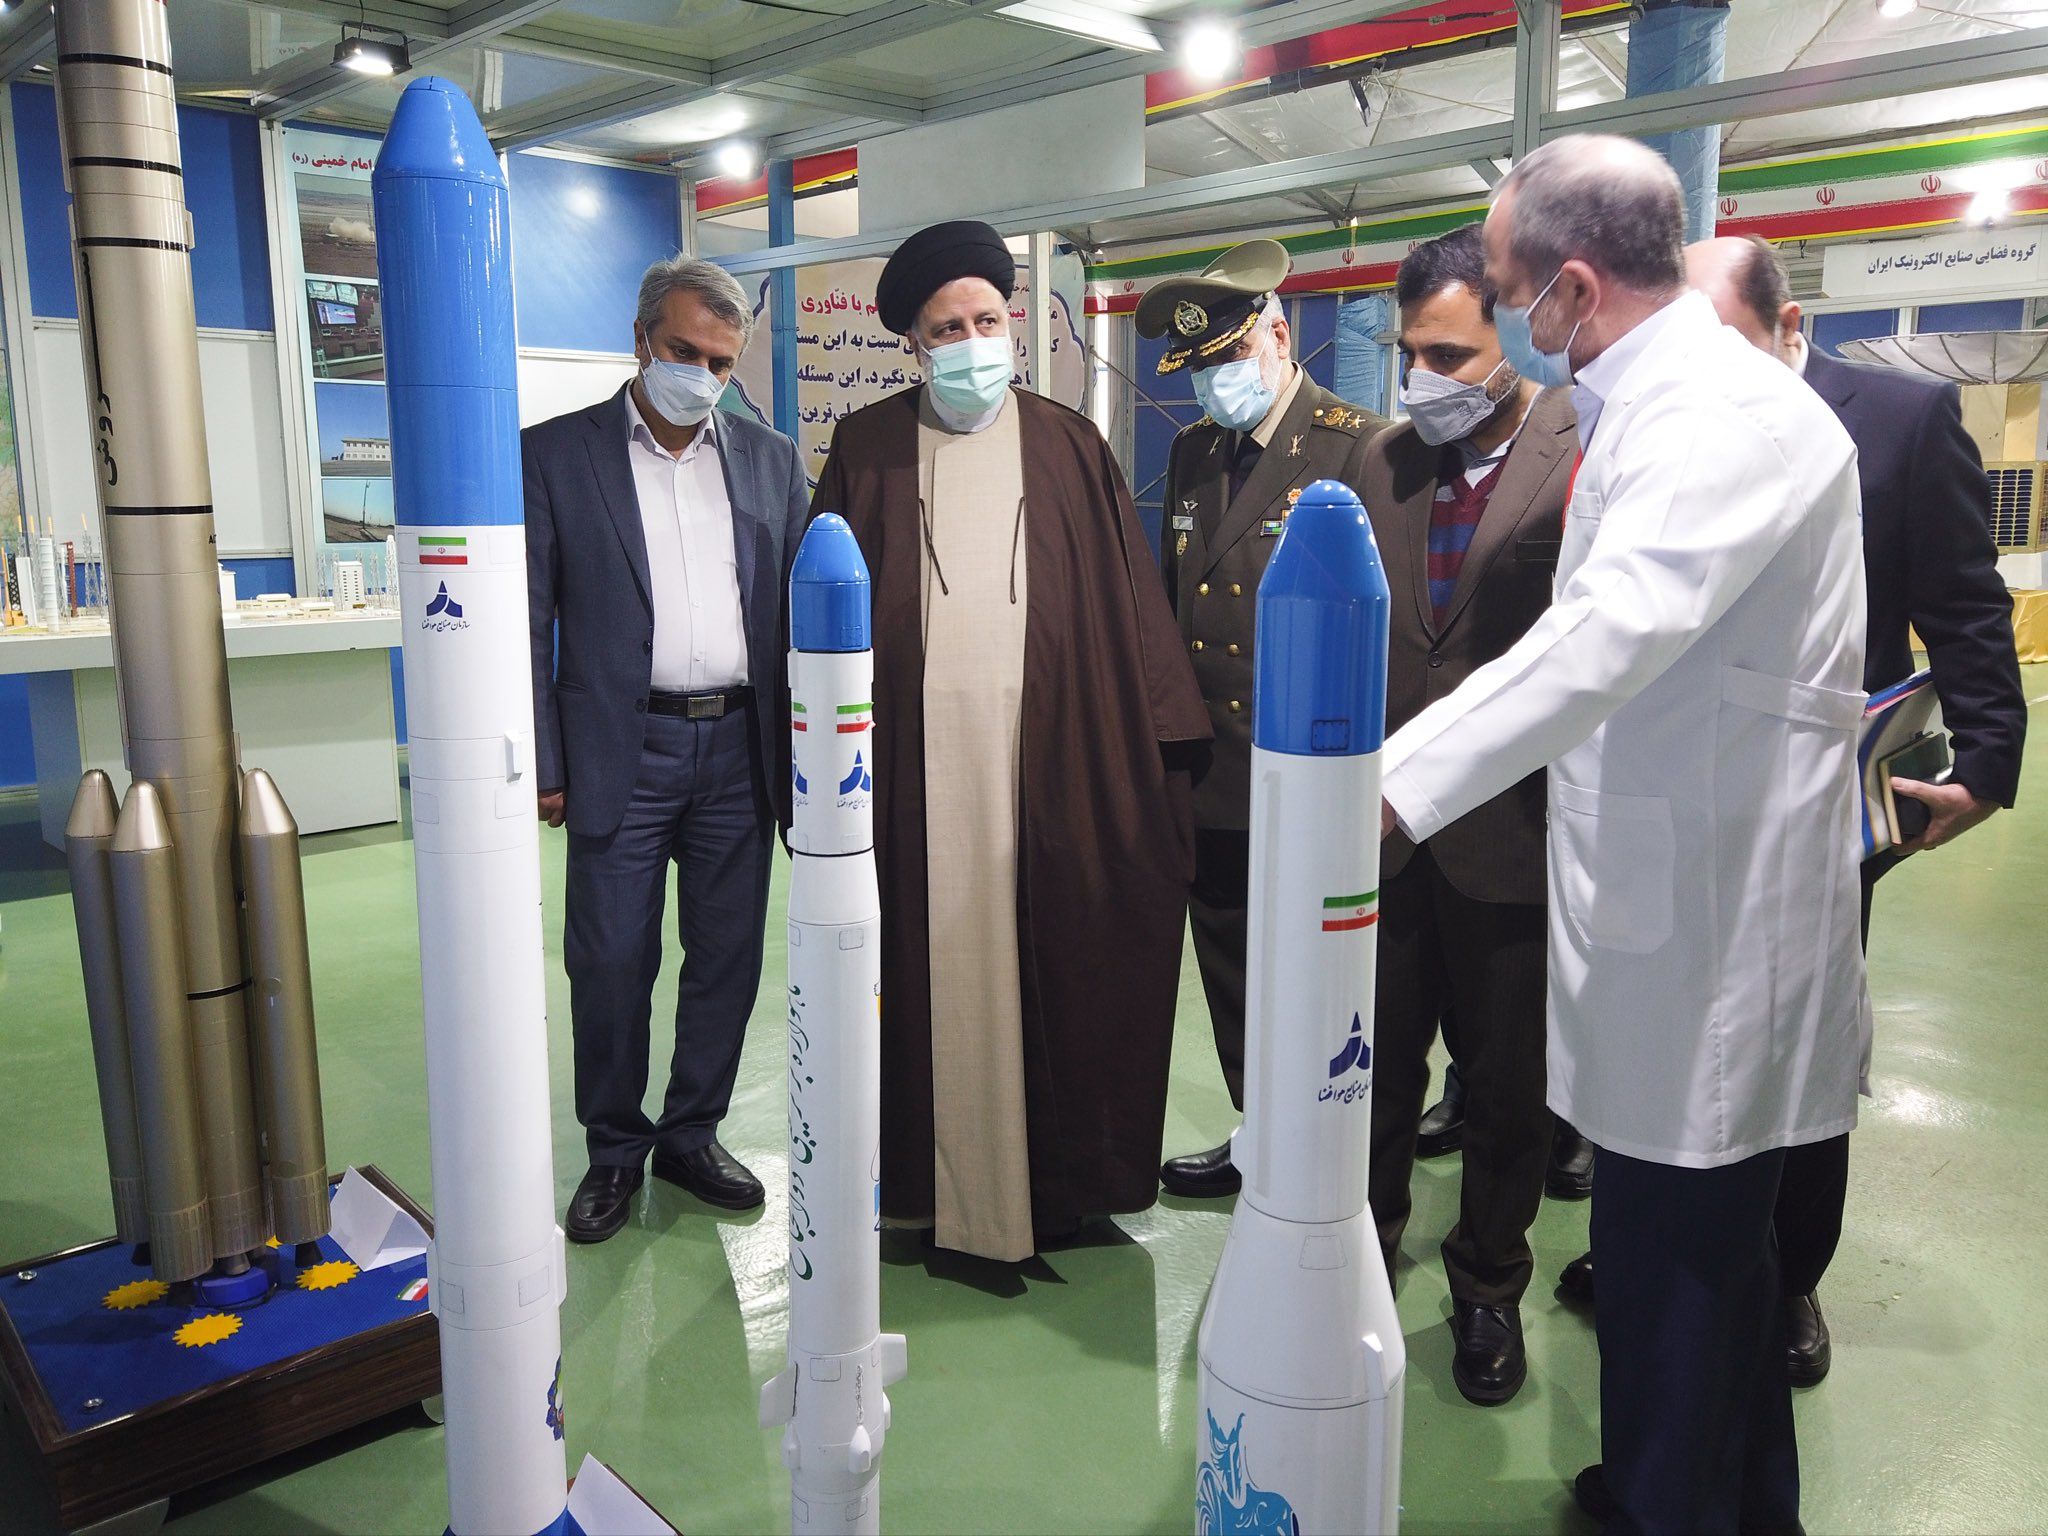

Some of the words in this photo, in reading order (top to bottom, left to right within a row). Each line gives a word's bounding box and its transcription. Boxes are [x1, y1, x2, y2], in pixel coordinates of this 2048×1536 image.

[312, 155, 348, 168] خمینی
[351, 158, 373, 172] امام
[1895, 252, 1943, 270] الکترونیک
[1944, 250, 1973, 268] صنایع
[1975, 245, 2008, 265] فضایی
[2010, 243, 2037, 262] گروه
[1868, 257, 1892, 274] ایران
[851, 294, 862, 315] با
[823, 329, 847, 351] این
[850, 334, 863, 351] به
[838, 367, 860, 388] این
